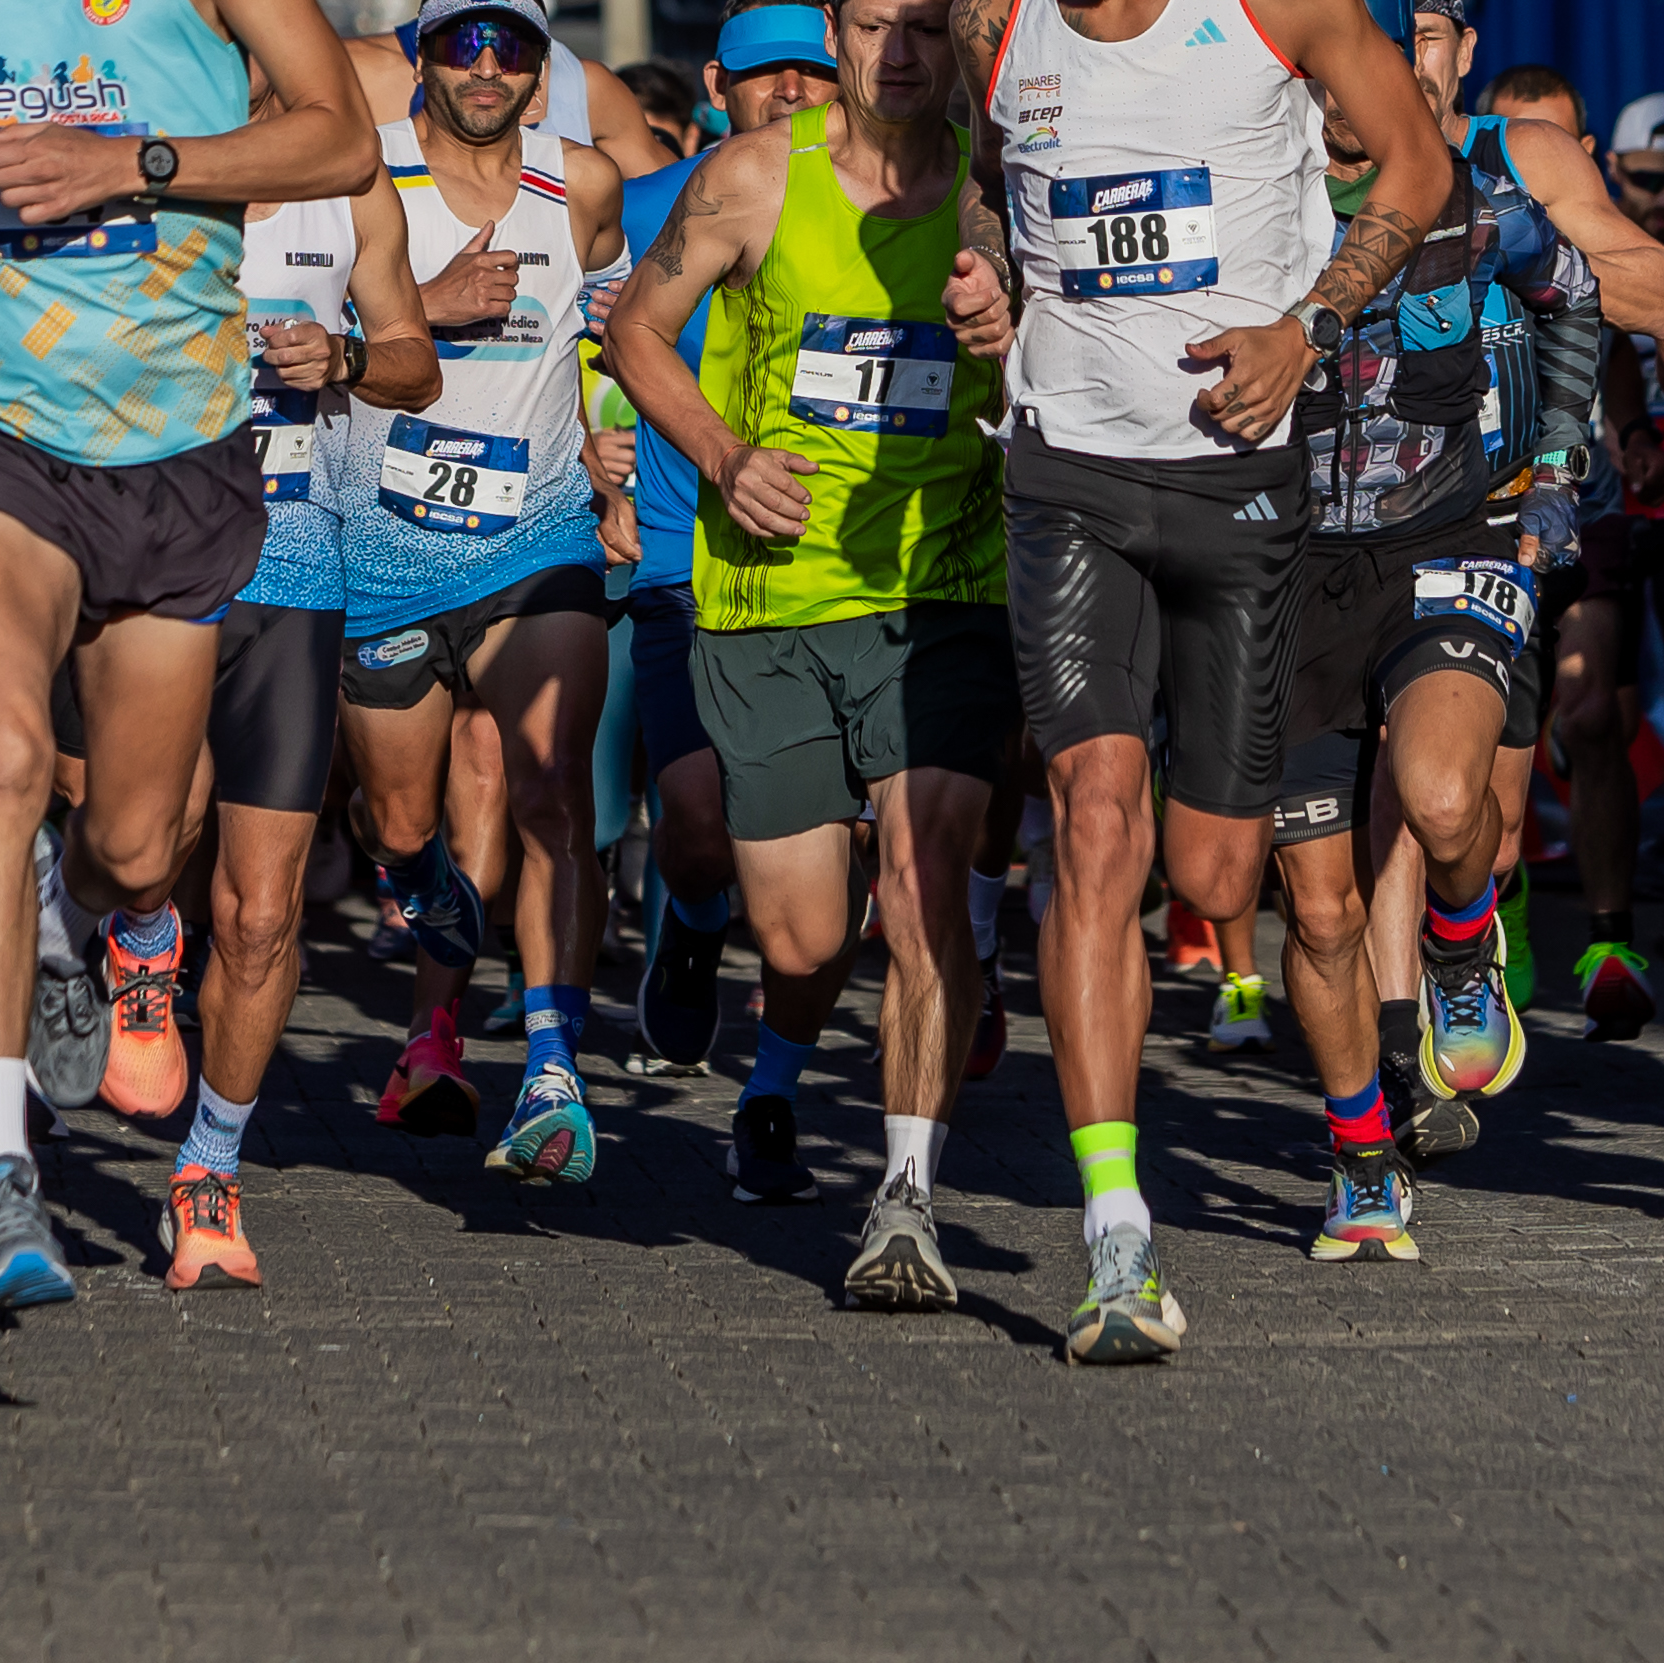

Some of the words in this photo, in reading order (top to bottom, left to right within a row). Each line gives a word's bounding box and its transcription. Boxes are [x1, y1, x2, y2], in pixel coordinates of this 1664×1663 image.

[1018, 73, 1062, 89] PINARES
[1018, 89, 1061, 104] PLACE
[88, 111, 121, 124] RICA
[1030, 105, 1064, 124] cep
[1094, 181, 1149, 207] CARRERA
[1087, 213, 1170, 266] 188
[854, 359, 896, 404] 17
[422, 461, 479, 508] 28
